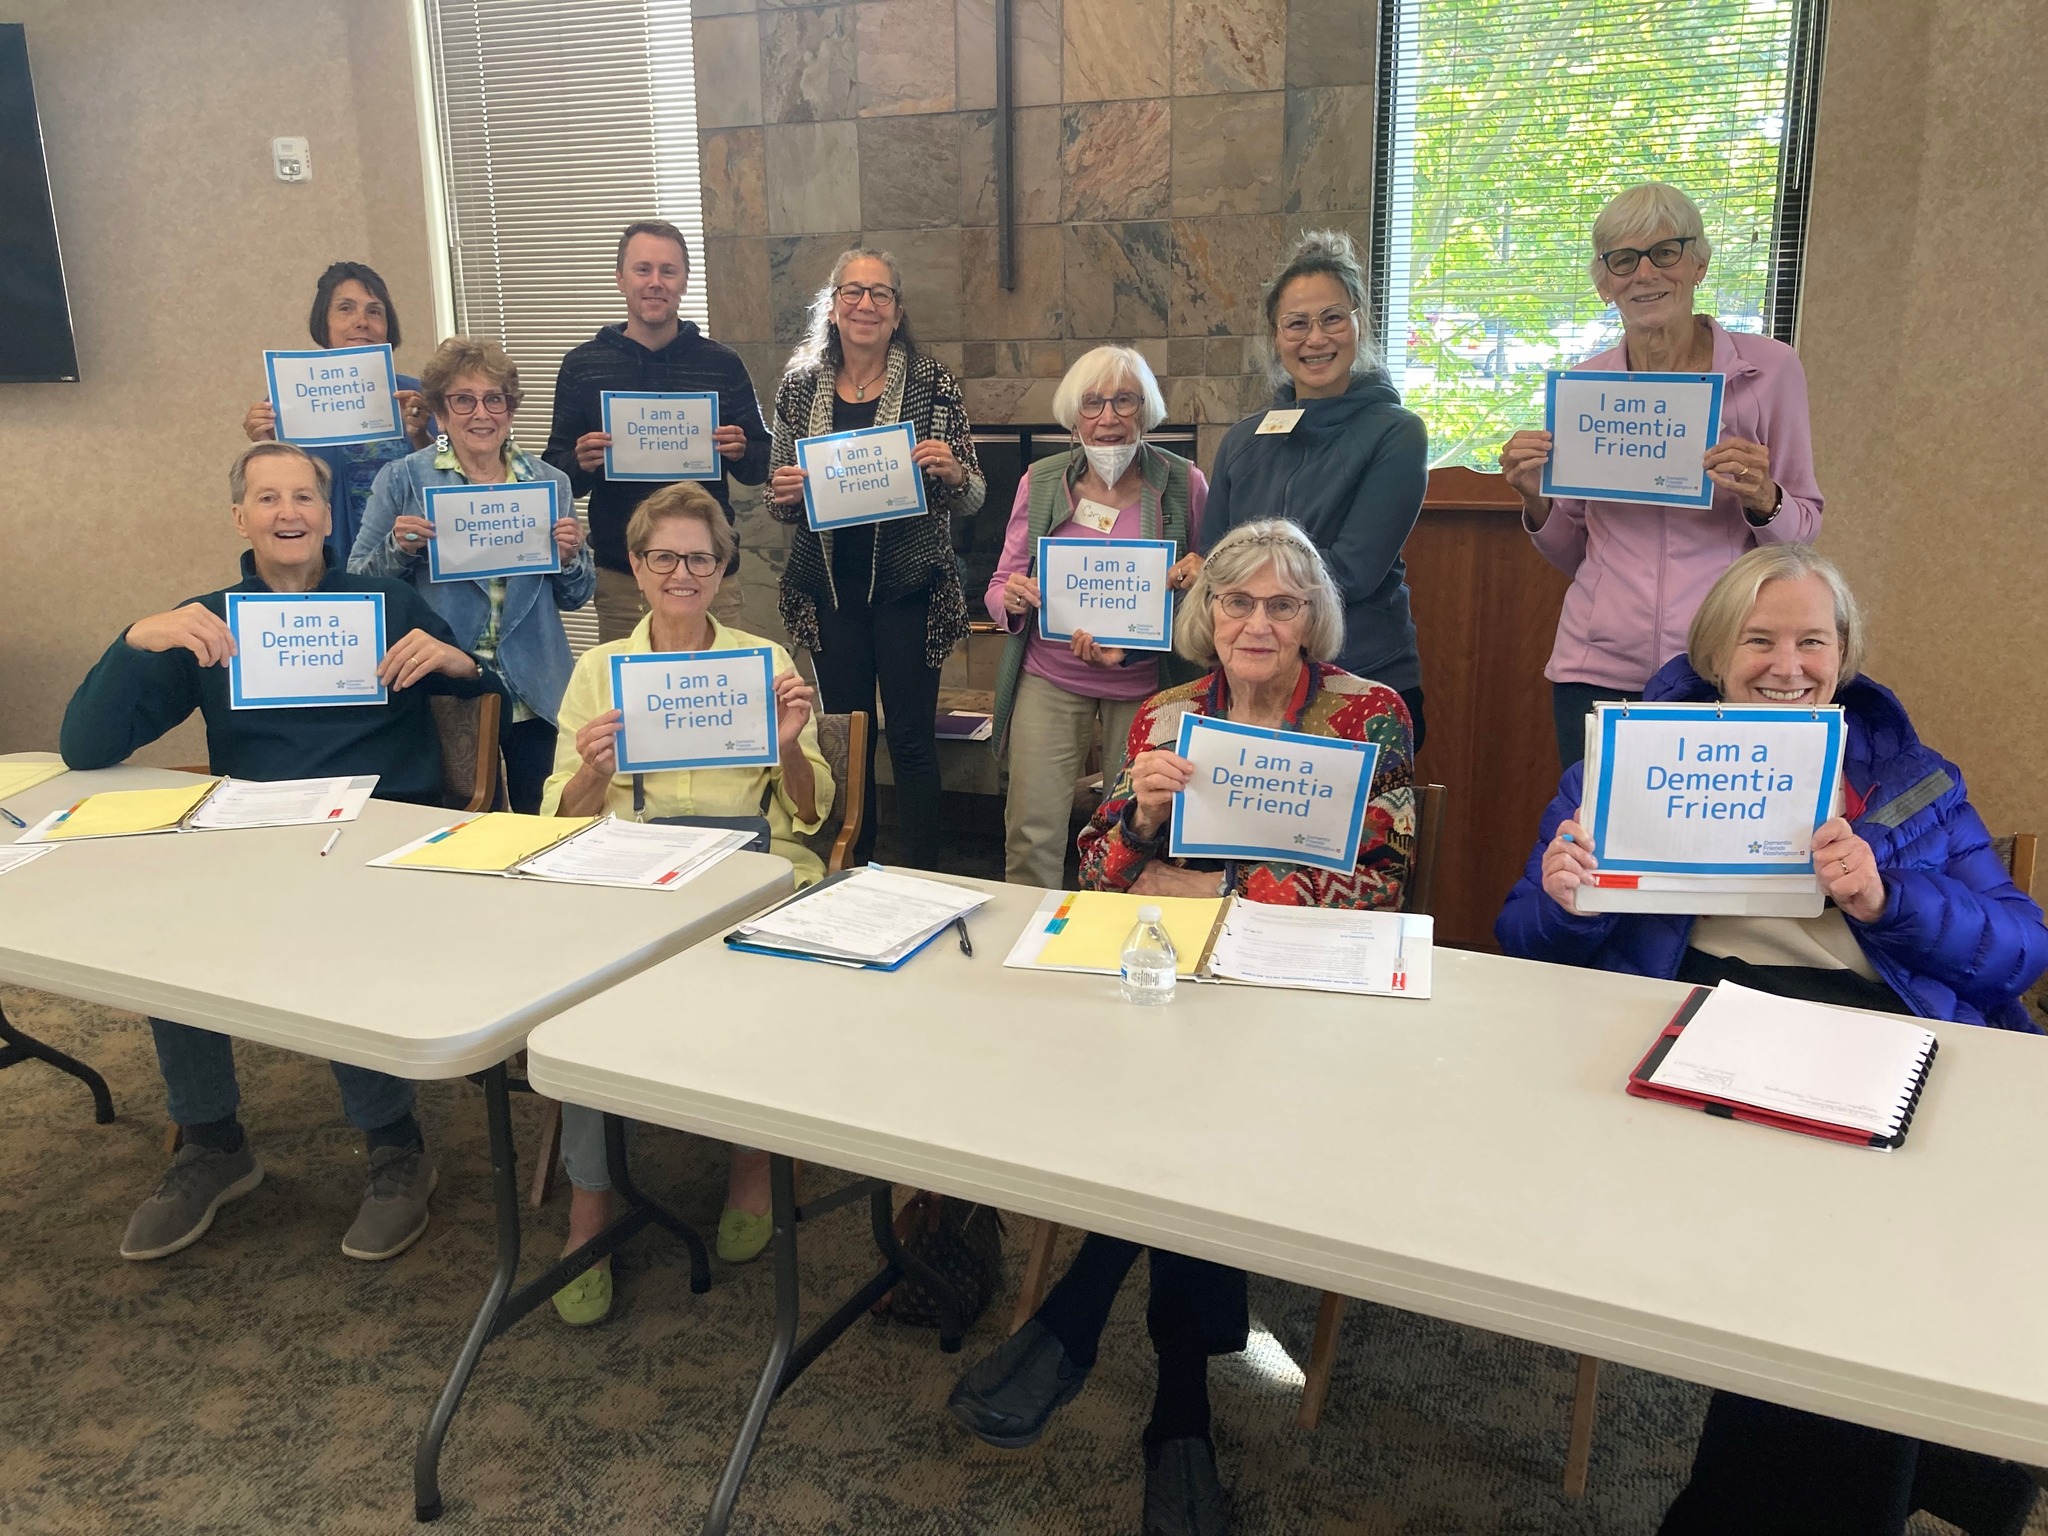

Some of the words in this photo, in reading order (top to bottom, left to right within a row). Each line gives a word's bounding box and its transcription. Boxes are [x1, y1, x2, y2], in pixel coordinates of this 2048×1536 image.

[309, 367, 314, 380] I
[321, 368, 344, 380] am
[350, 367, 358, 377] a
[296, 379, 375, 397] Dementia
[311, 396, 365, 413] Friend
[1601, 393, 1605, 411] I
[1614, 398, 1645, 413] am
[1654, 400, 1666, 414] a
[641, 408, 644, 419] I
[651, 411, 671, 420] am
[677, 411, 684, 420] a
[628, 422, 699, 435] Dementia
[1579, 414, 1686, 438] Dementia
[640, 438, 688, 450] Friend
[1595, 437, 1666, 458] Friend
[837, 448, 841, 462] I
[847, 448, 869, 459] am
[874, 446, 882, 456] a
[825, 457, 898, 480] Dementia
[839, 474, 889, 494] Friend
[470, 502, 474, 515] I
[481, 503, 504, 514] am
[511, 502, 519, 512] a
[455, 515, 536, 532] Dementia
[470, 531, 524, 547] Friend
[1084, 556, 1087, 571] I
[1095, 560, 1119, 572] am
[1126, 561, 1135, 572] a
[1067, 574, 1150, 592] Dementia
[1080, 593, 1136, 609] Friend
[281, 612, 285, 628] I
[294, 616, 321, 628] am
[329, 615, 339, 627] a
[262, 630, 358, 648] Dementia
[279, 650, 343, 666] Friend
[666, 673, 671, 690] I
[680, 675, 709, 689] am
[717, 674, 727, 687] a
[647, 689, 747, 711] Dementia
[665, 709, 732, 729] Friend
[1679, 737, 1684, 762] I
[1697, 743, 1740, 762] am
[1751, 744, 1768, 763] a
[1239, 748, 1246, 766] I
[1254, 755, 1291, 772] am
[1300, 761, 1313, 775] a
[1212, 767, 1333, 798] Dementia
[1647, 766, 1793, 791] Dementia
[1228, 791, 1310, 817] Friend
[1667, 795, 1767, 819] Friend
